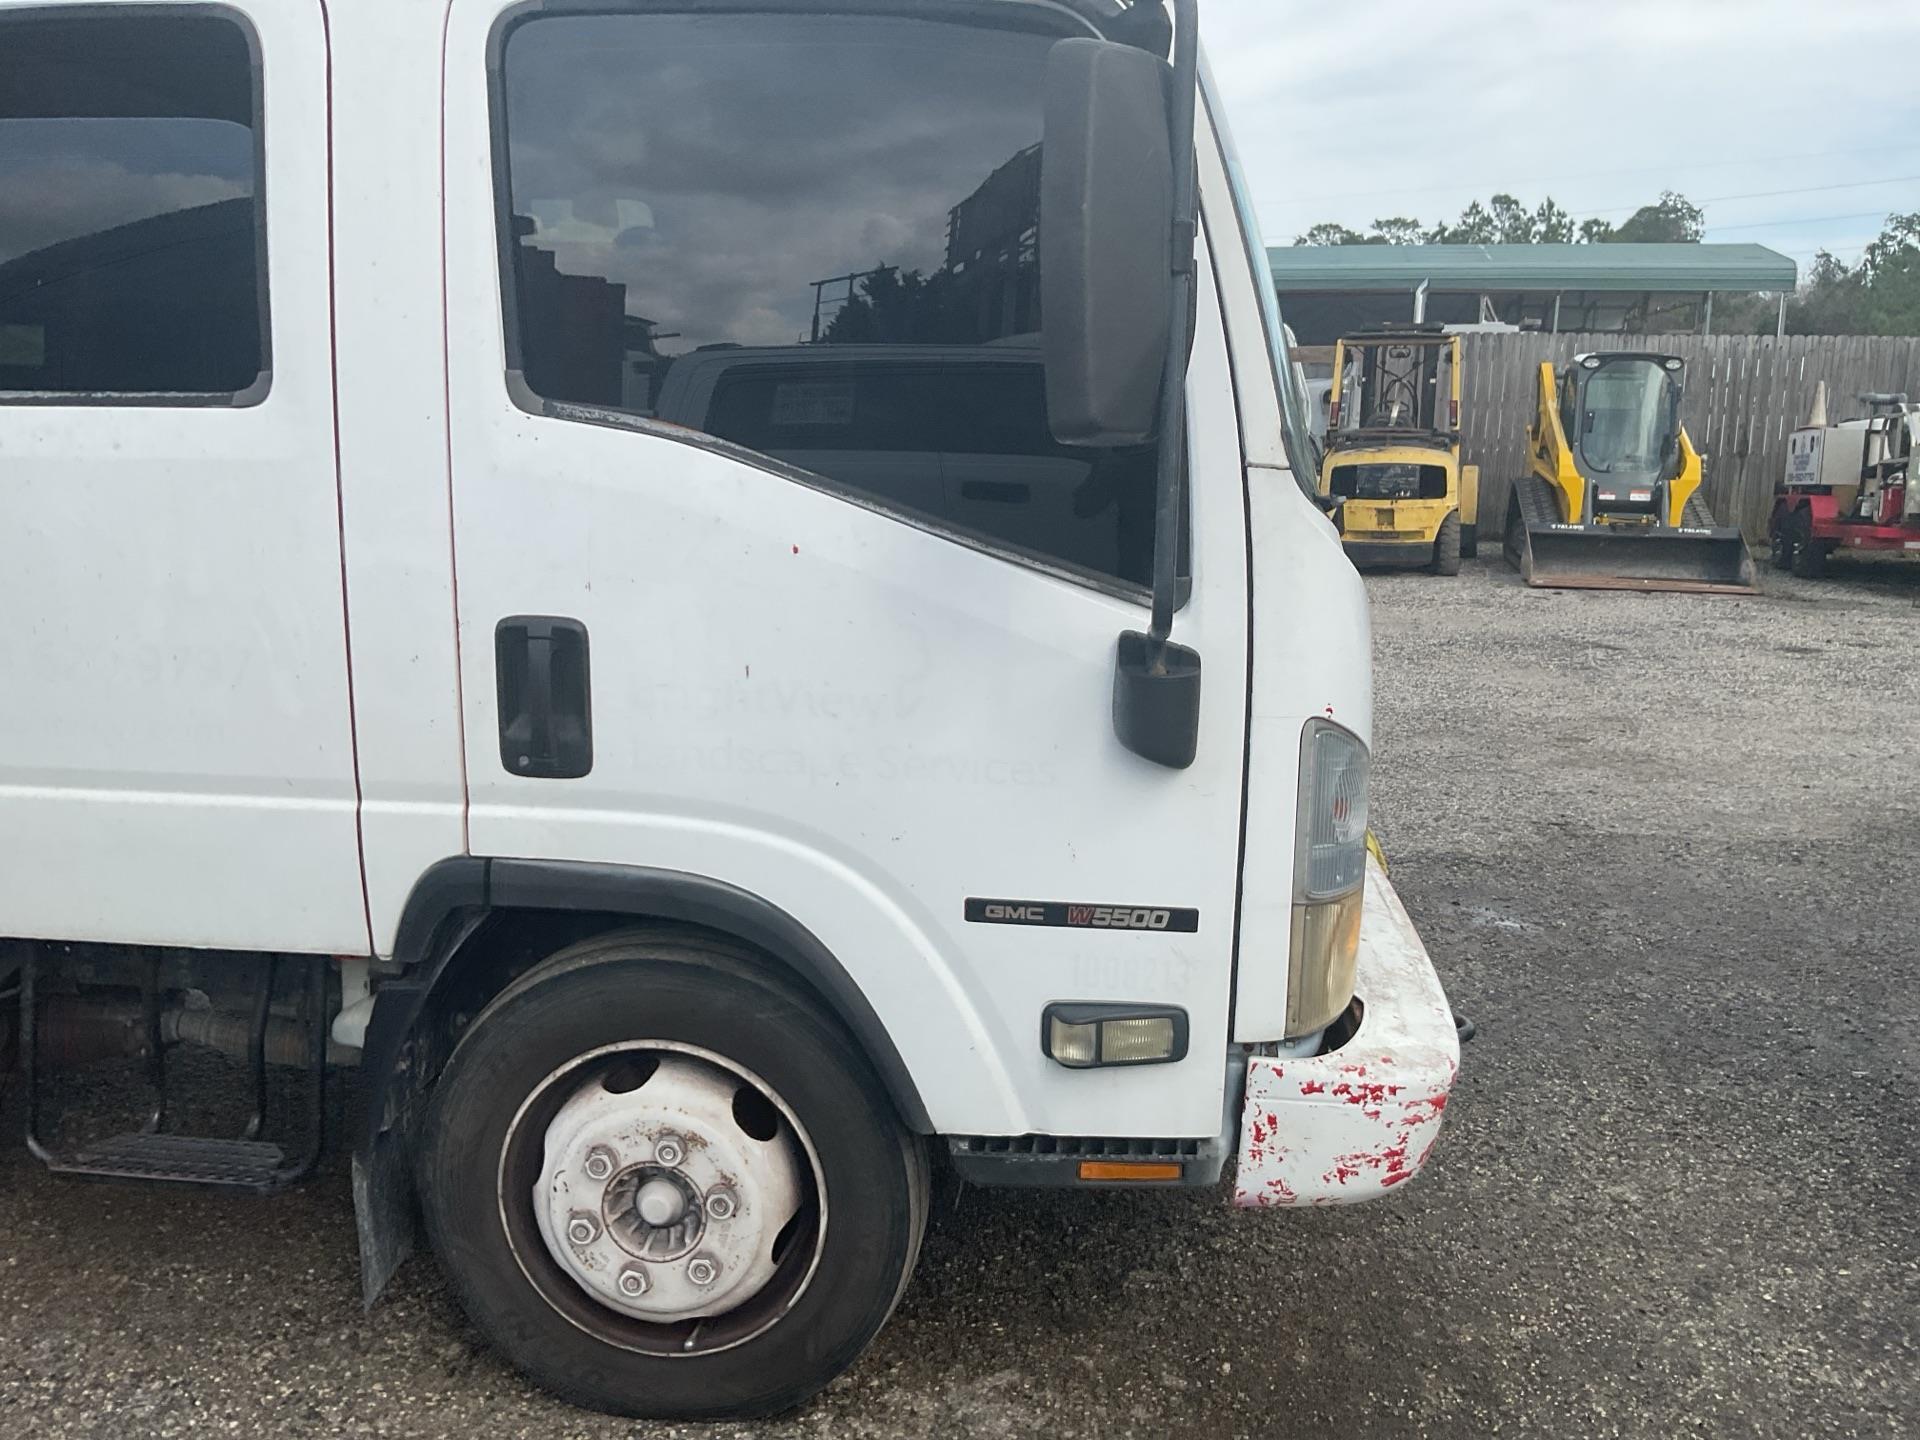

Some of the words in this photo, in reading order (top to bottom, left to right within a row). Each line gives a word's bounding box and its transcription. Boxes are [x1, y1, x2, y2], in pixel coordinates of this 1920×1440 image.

[630, 736, 863, 787] Landscape
[875, 743, 1060, 787] Services
[985, 905, 1044, 921] GMC
[1067, 905, 1171, 929] W5500
